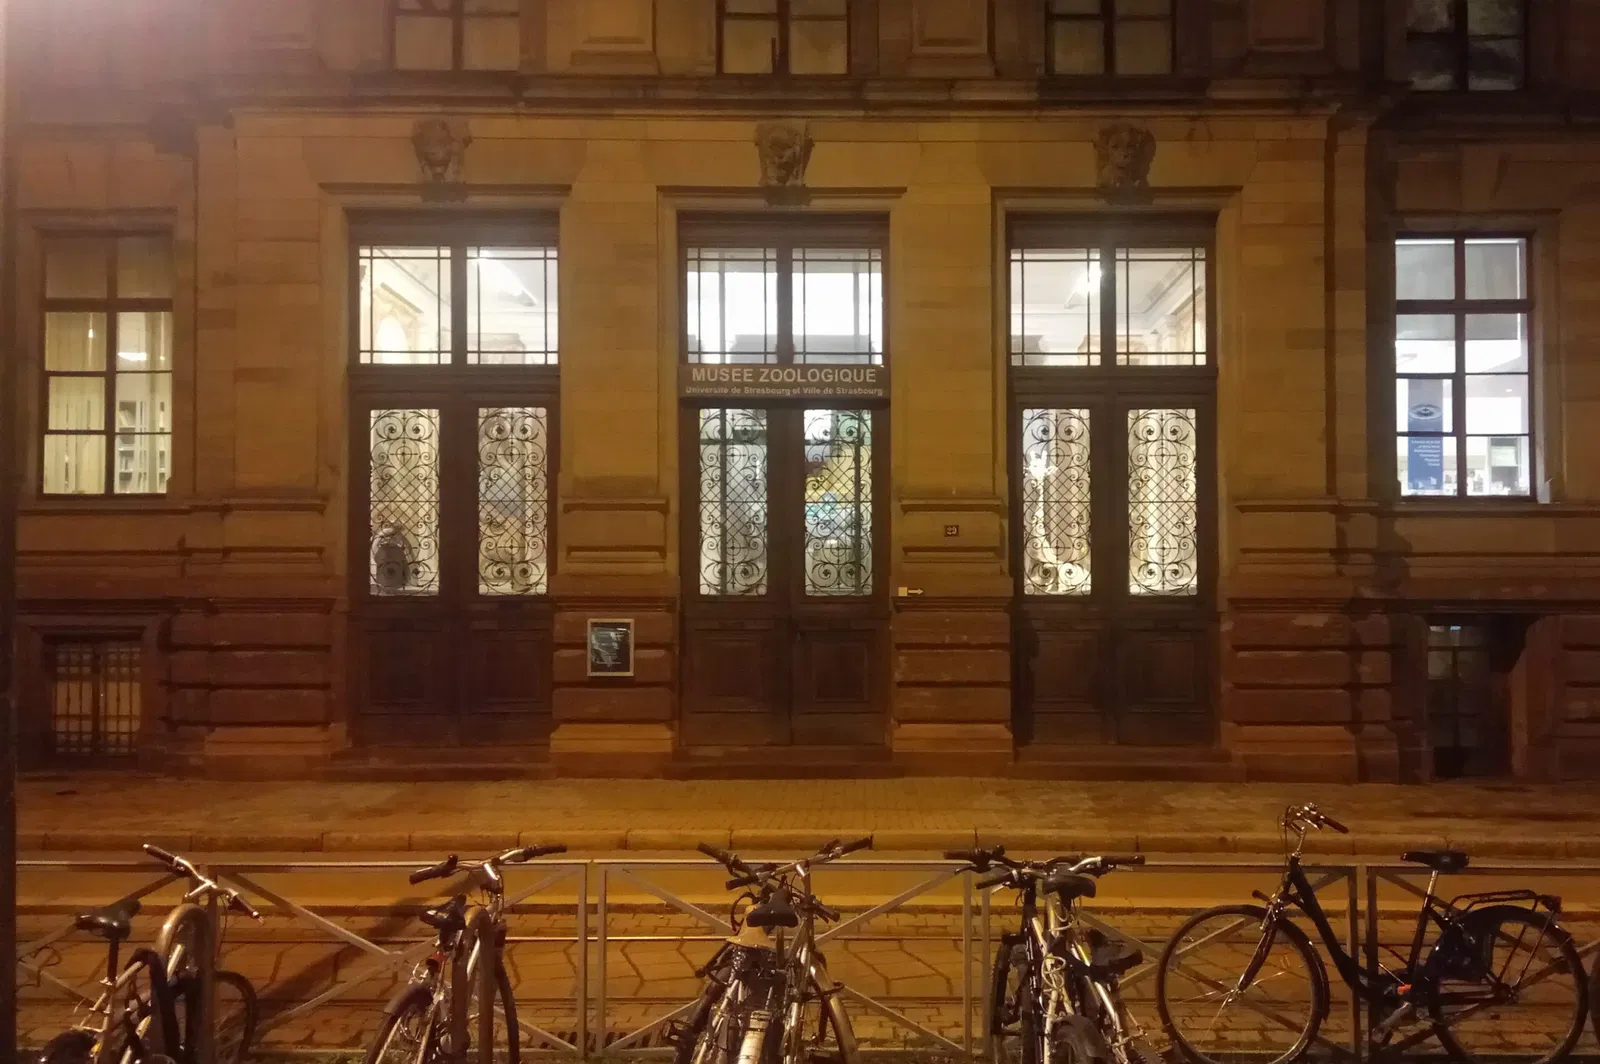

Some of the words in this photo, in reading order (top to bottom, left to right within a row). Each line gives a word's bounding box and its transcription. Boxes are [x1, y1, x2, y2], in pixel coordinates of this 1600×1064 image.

[692, 368, 754, 382] MUSEE
[758, 368, 876, 383] ZOOLOGIQUE
[731, 386, 742, 394] de
[744, 386, 790, 396] Strasbourg
[836, 387, 883, 396] Strasbourg
